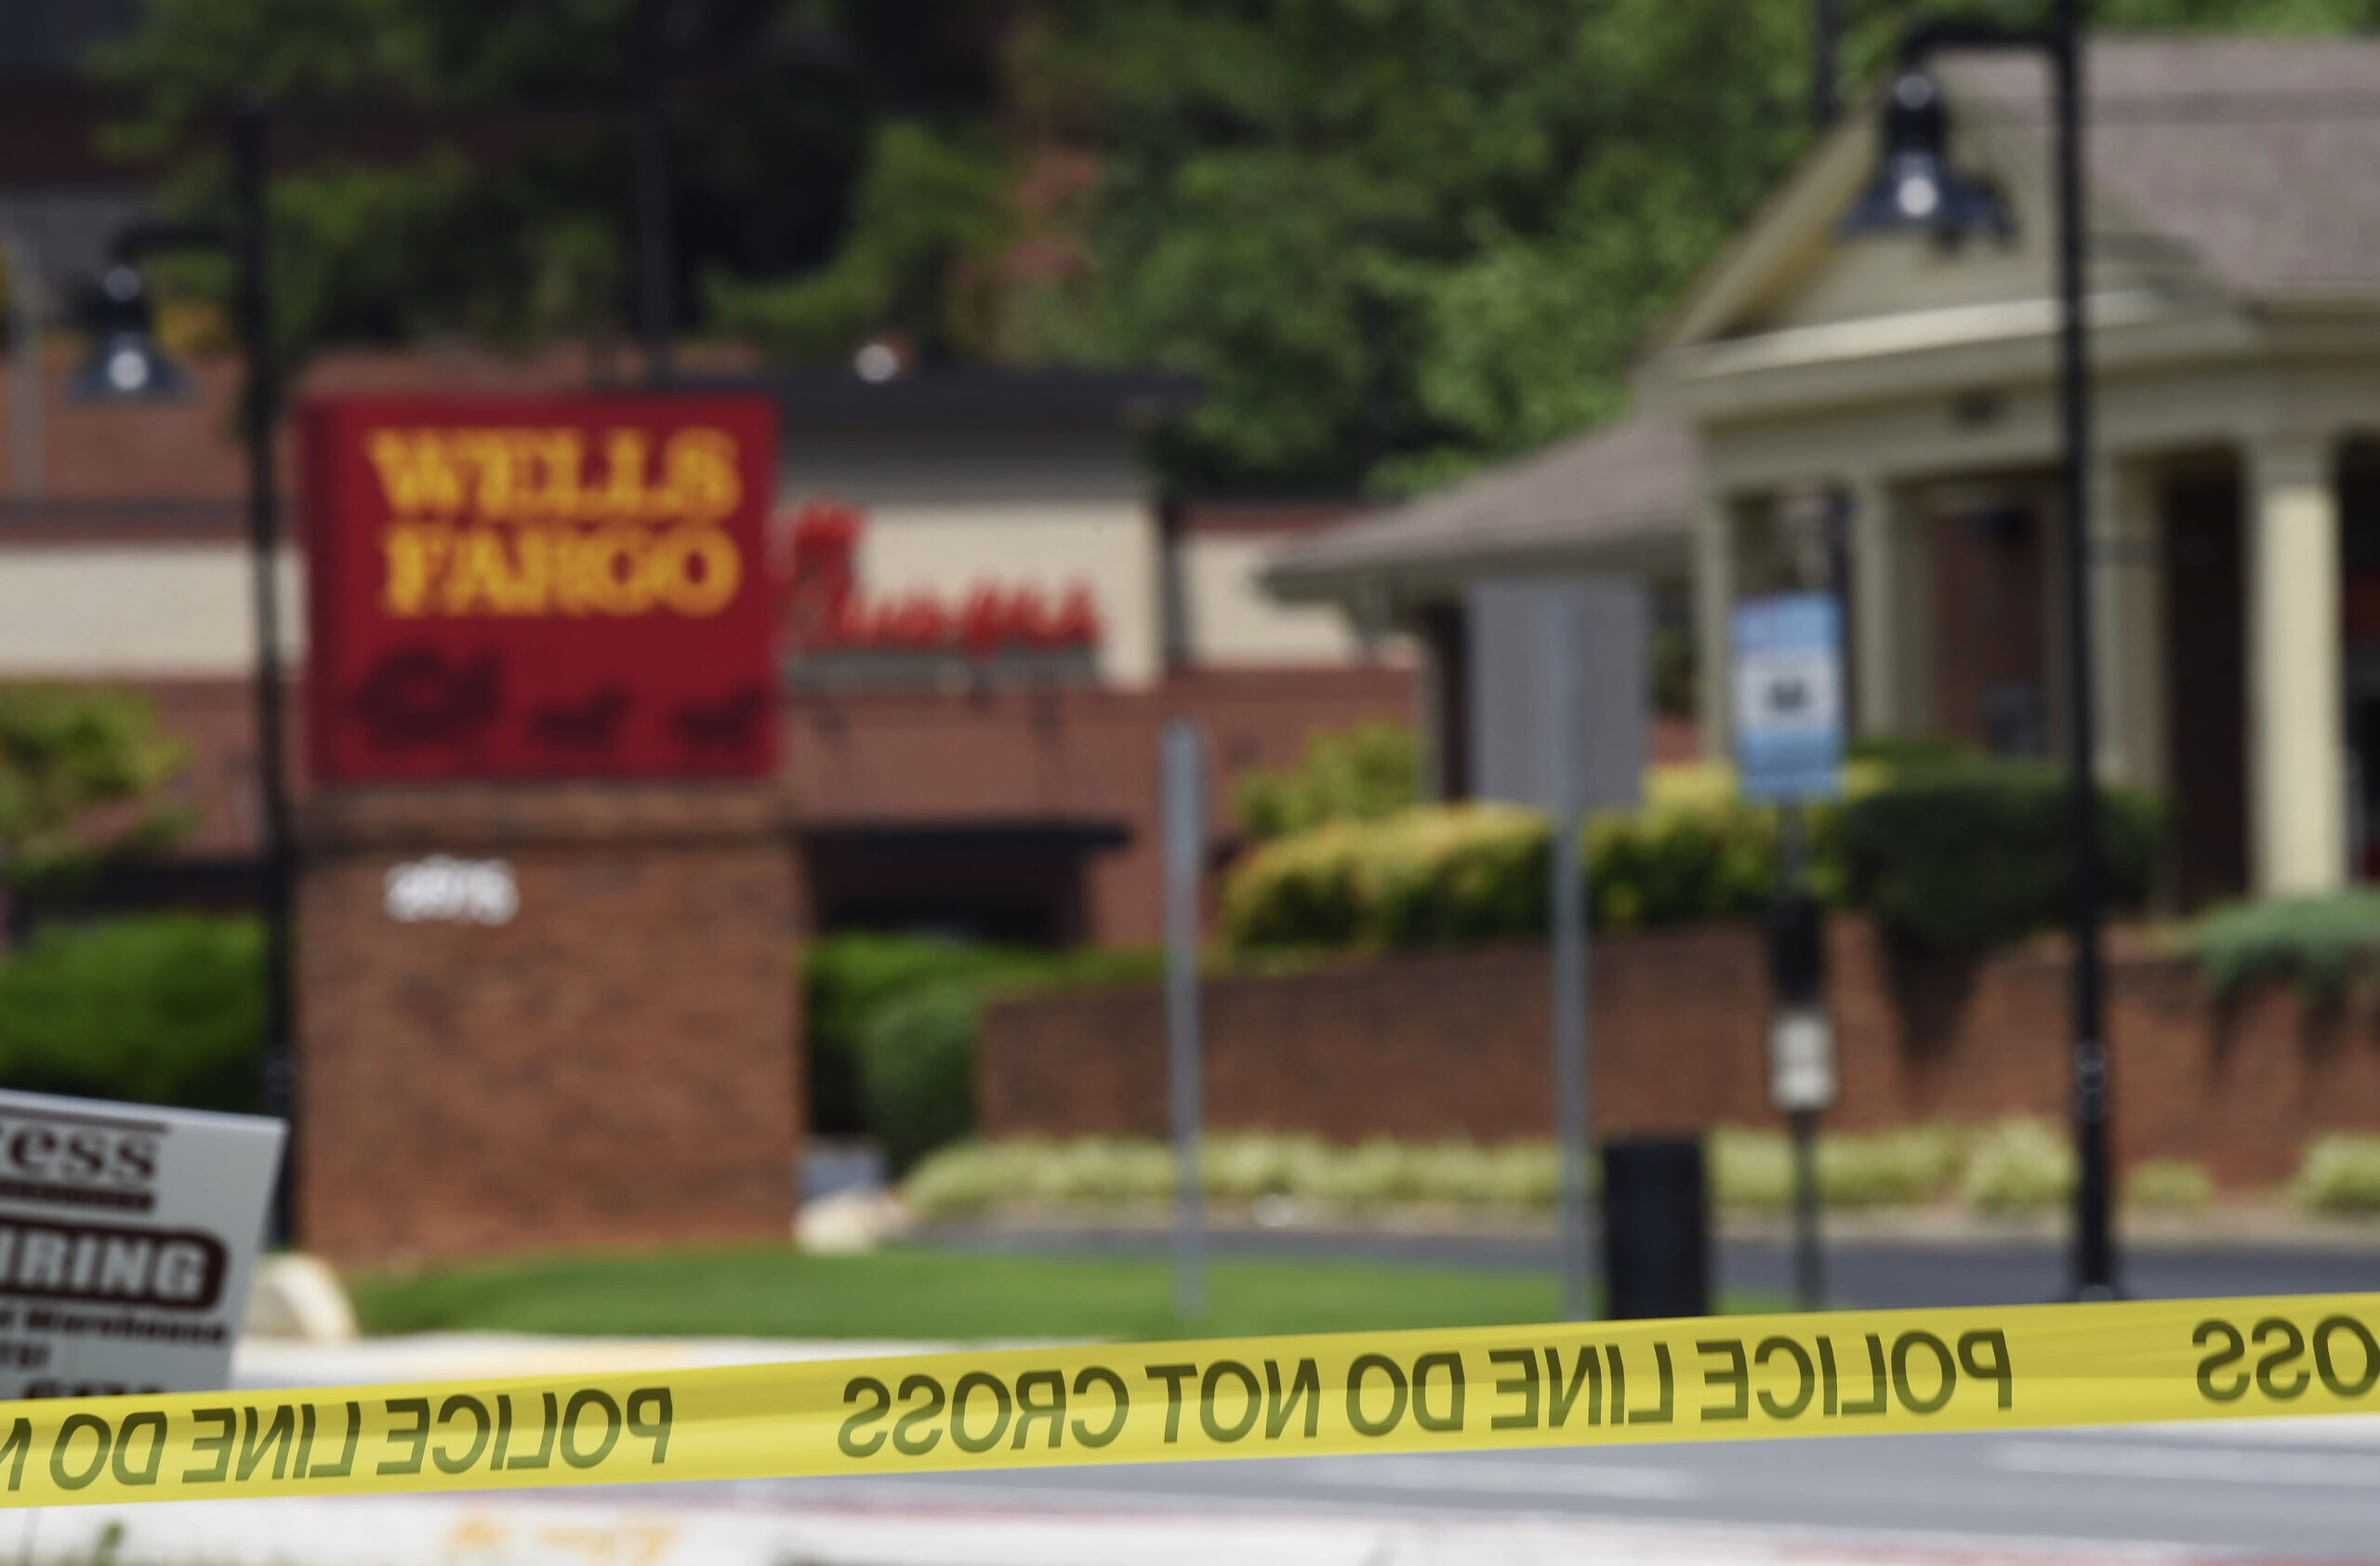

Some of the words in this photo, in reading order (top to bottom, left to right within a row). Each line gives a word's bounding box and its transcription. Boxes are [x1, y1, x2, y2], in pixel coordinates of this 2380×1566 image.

[370, 428, 741, 519] WELLS
[379, 523, 741, 617] FARGO
[0, 1121, 160, 1182] ess
